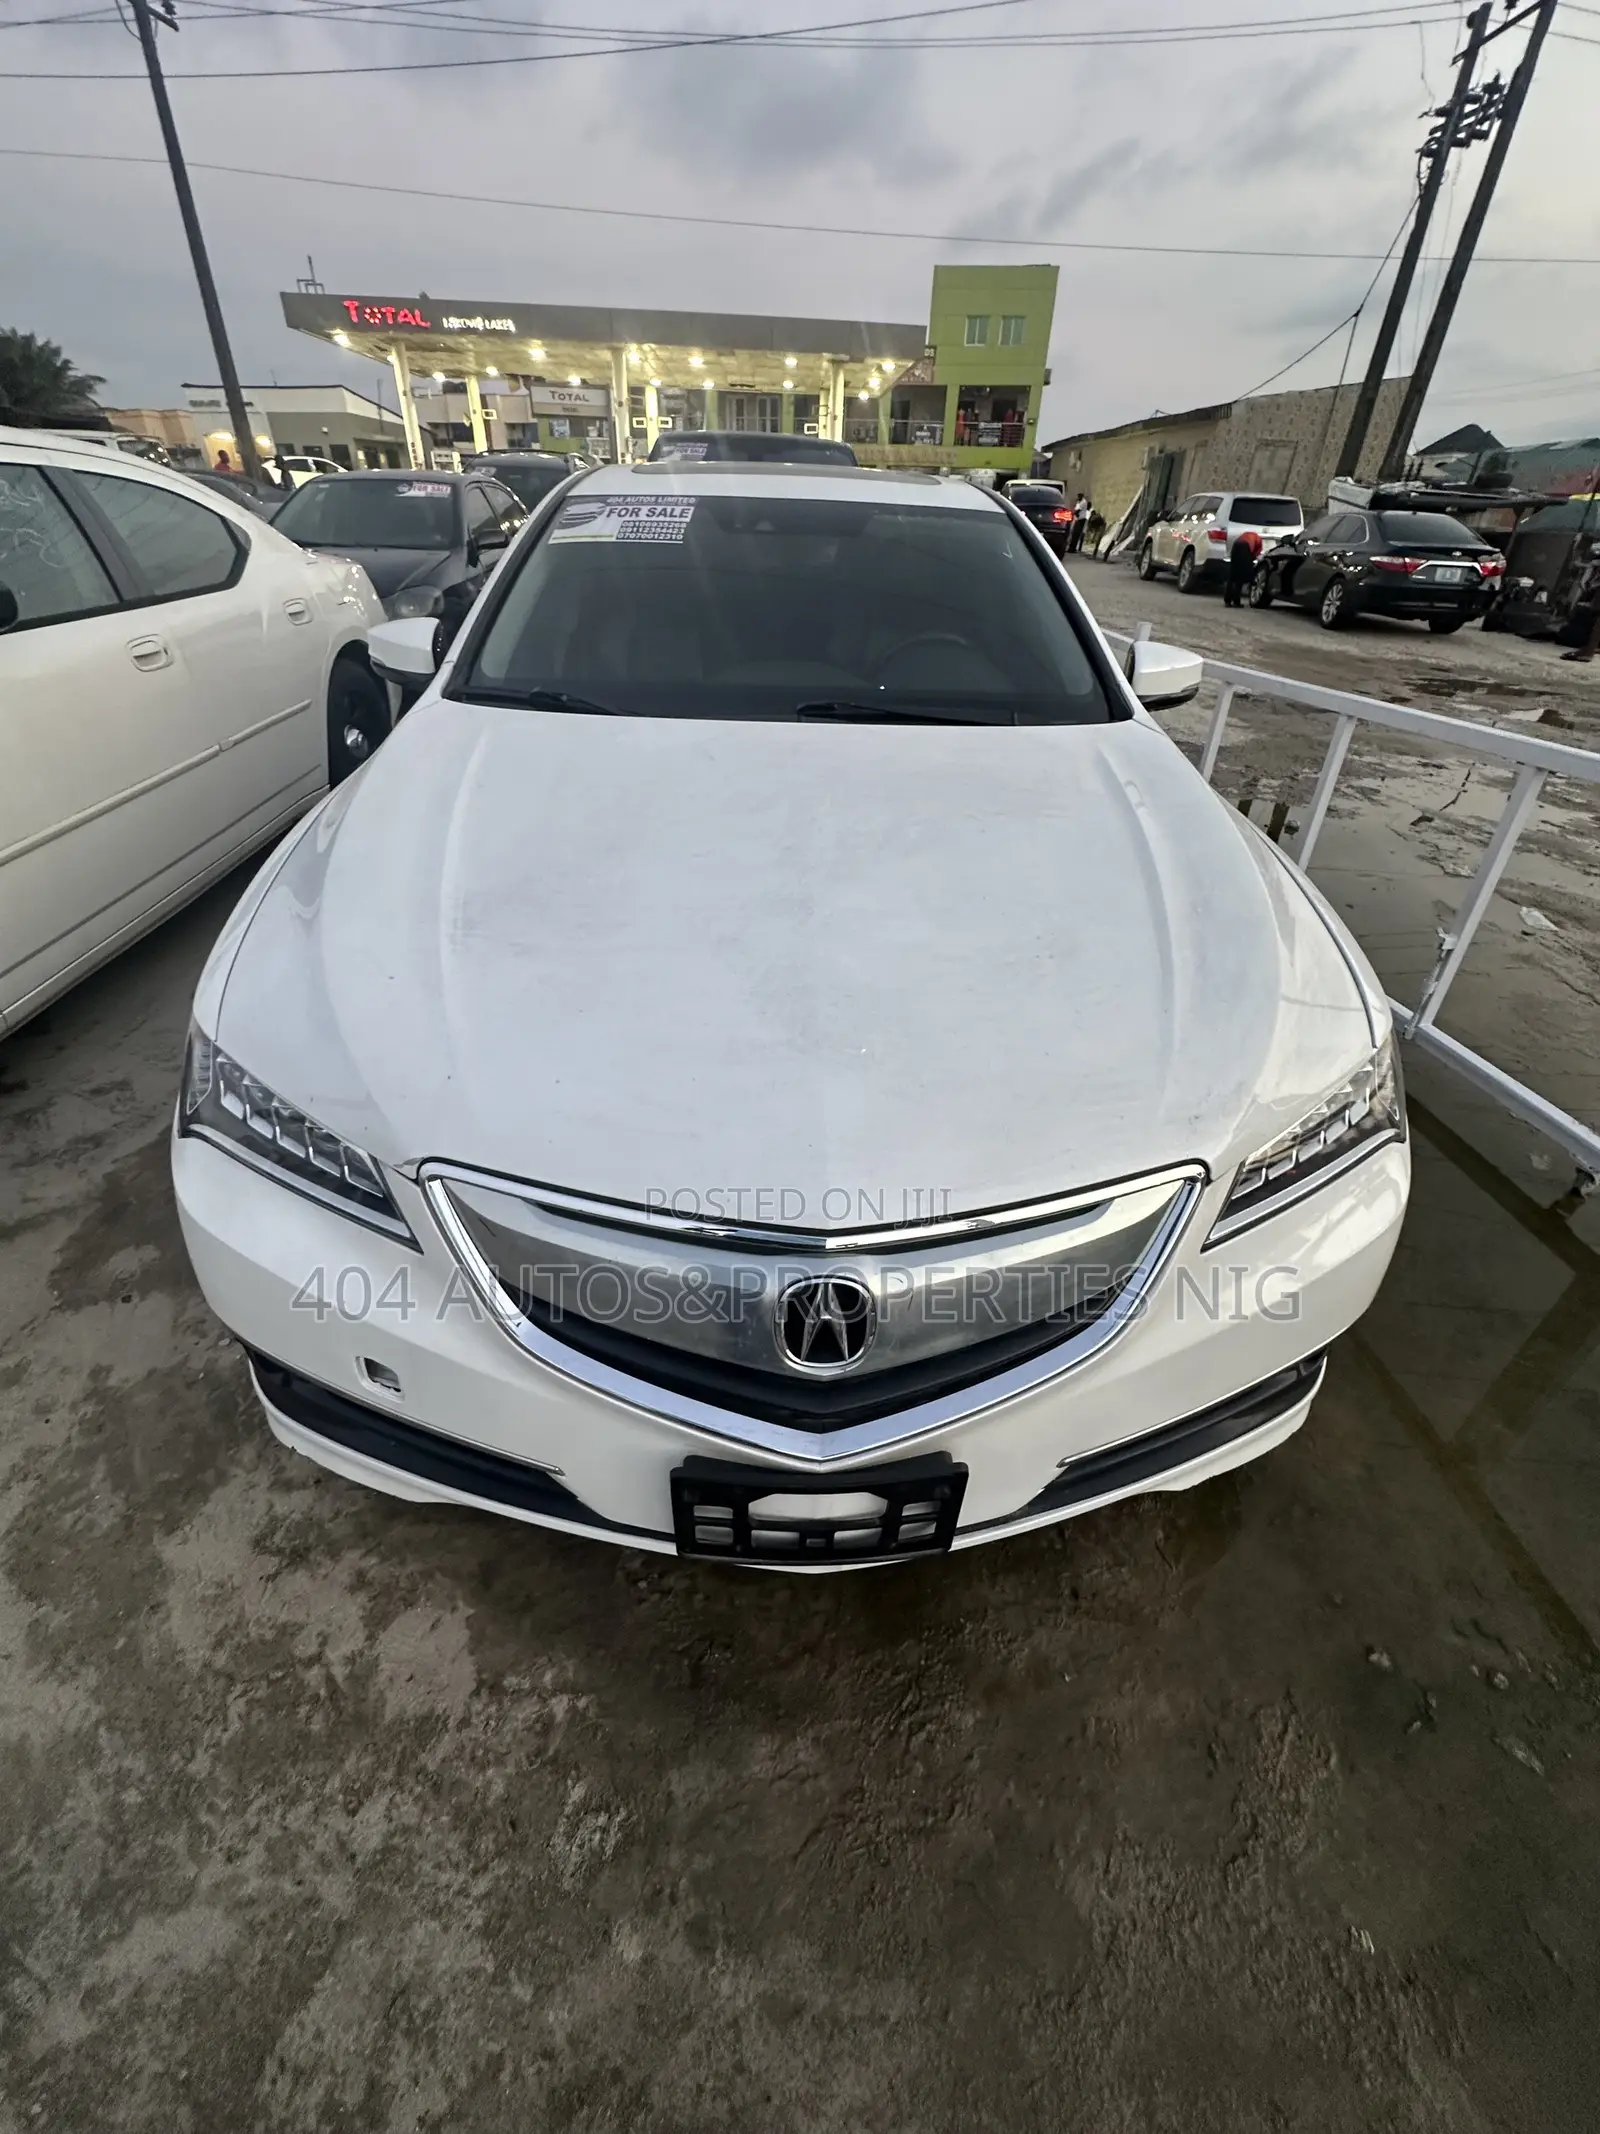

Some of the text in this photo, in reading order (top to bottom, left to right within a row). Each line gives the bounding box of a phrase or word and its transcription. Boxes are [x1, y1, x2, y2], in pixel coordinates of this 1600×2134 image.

[343, 300, 431, 328] TOTAL
[549, 390, 590, 403] TOTAL
[606, 507, 691, 519] FOR SALE
